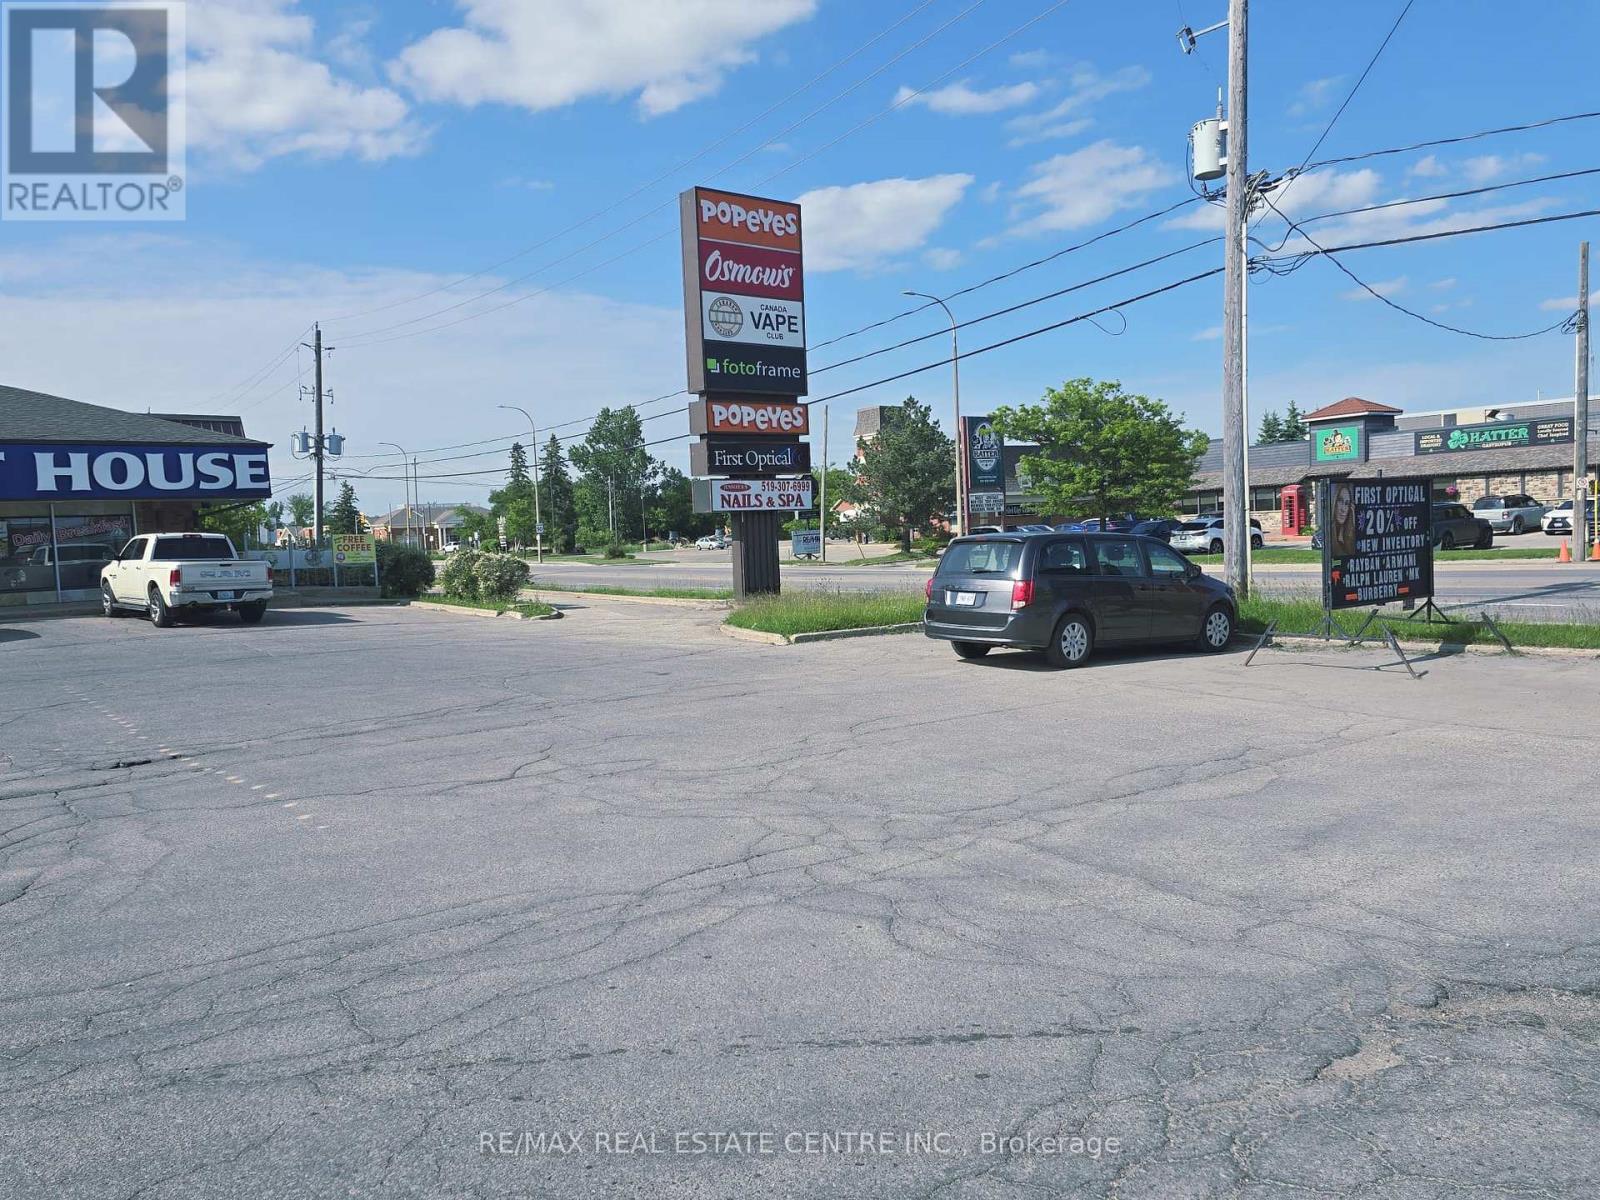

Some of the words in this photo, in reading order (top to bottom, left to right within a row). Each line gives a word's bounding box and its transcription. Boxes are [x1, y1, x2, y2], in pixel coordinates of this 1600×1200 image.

[705, 249, 794, 288] Osmow's
[760, 303, 788, 313] CANADA
[750, 311, 799, 334] VAPE
[766, 332, 784, 340] CLUB
[722, 358, 801, 379] fotoframe
[1470, 427, 1530, 443] HATTER
[714, 450, 743, 466] First
[745, 448, 792, 471] Optical
[33, 451, 270, 491] HOUSE
[720, 493, 763, 509] NAILS
[766, 496, 776, 508] &
[778, 493, 805, 507] SPA
[1355, 486, 1382, 504] FIRST
[1386, 485, 1425, 503] OPTICAL
[1366, 508, 1394, 535] 20%
[1404, 517, 1418, 529] OFF
[336, 543, 372, 551] COFFEE
[343, 535, 365, 544] FREE
[1361, 537, 1379, 552] NEW
[1382, 534, 1425, 551] INVENTORY
[1345, 572, 1370, 588] RALPH
[1374, 569, 1403, 584] LAUREN
[1358, 584, 1399, 601] BURBERRY
